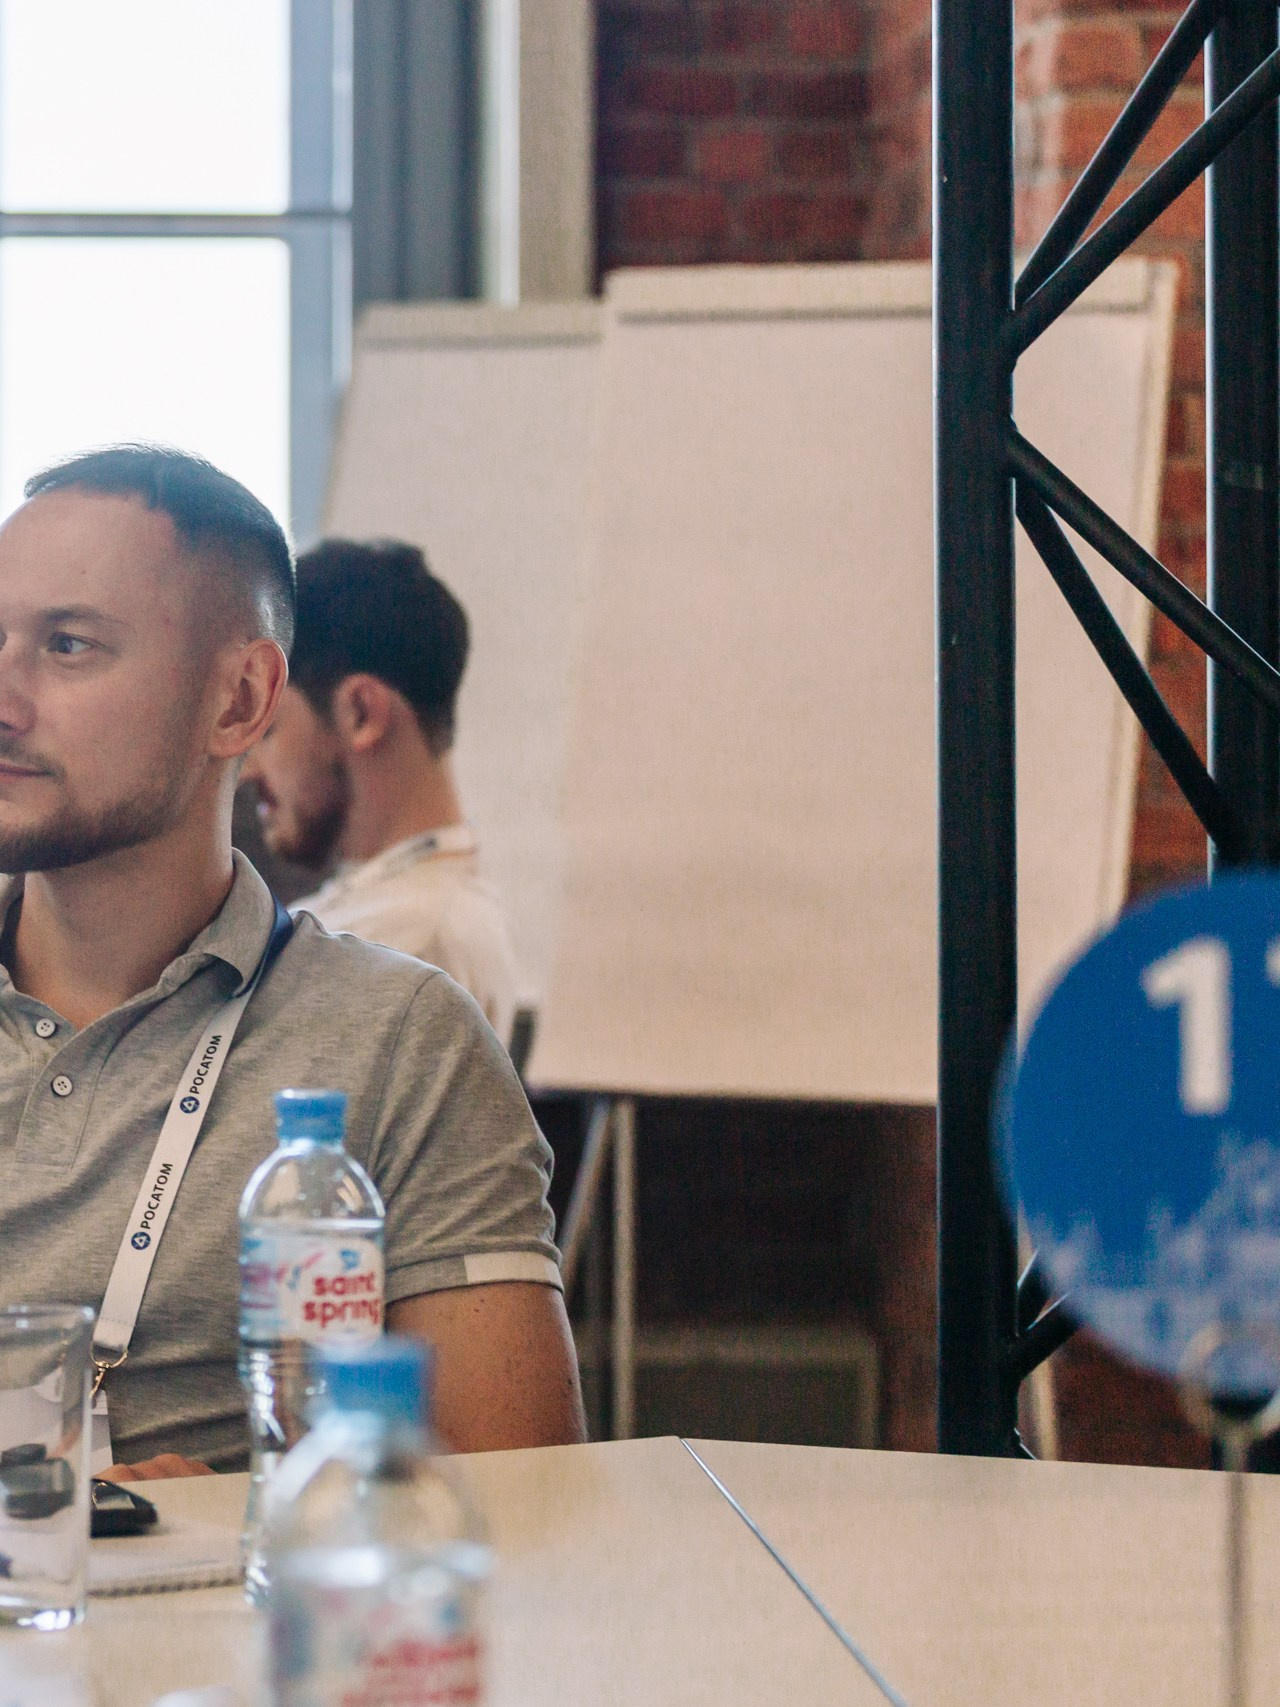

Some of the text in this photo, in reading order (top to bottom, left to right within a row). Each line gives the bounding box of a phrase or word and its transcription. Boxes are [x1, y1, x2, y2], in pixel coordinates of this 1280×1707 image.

[1140, 937, 1280, 1117] 1
[189, 1034, 222, 1095] РОСАТОМ
[140, 1163, 173, 1230] РОСАТОМ
